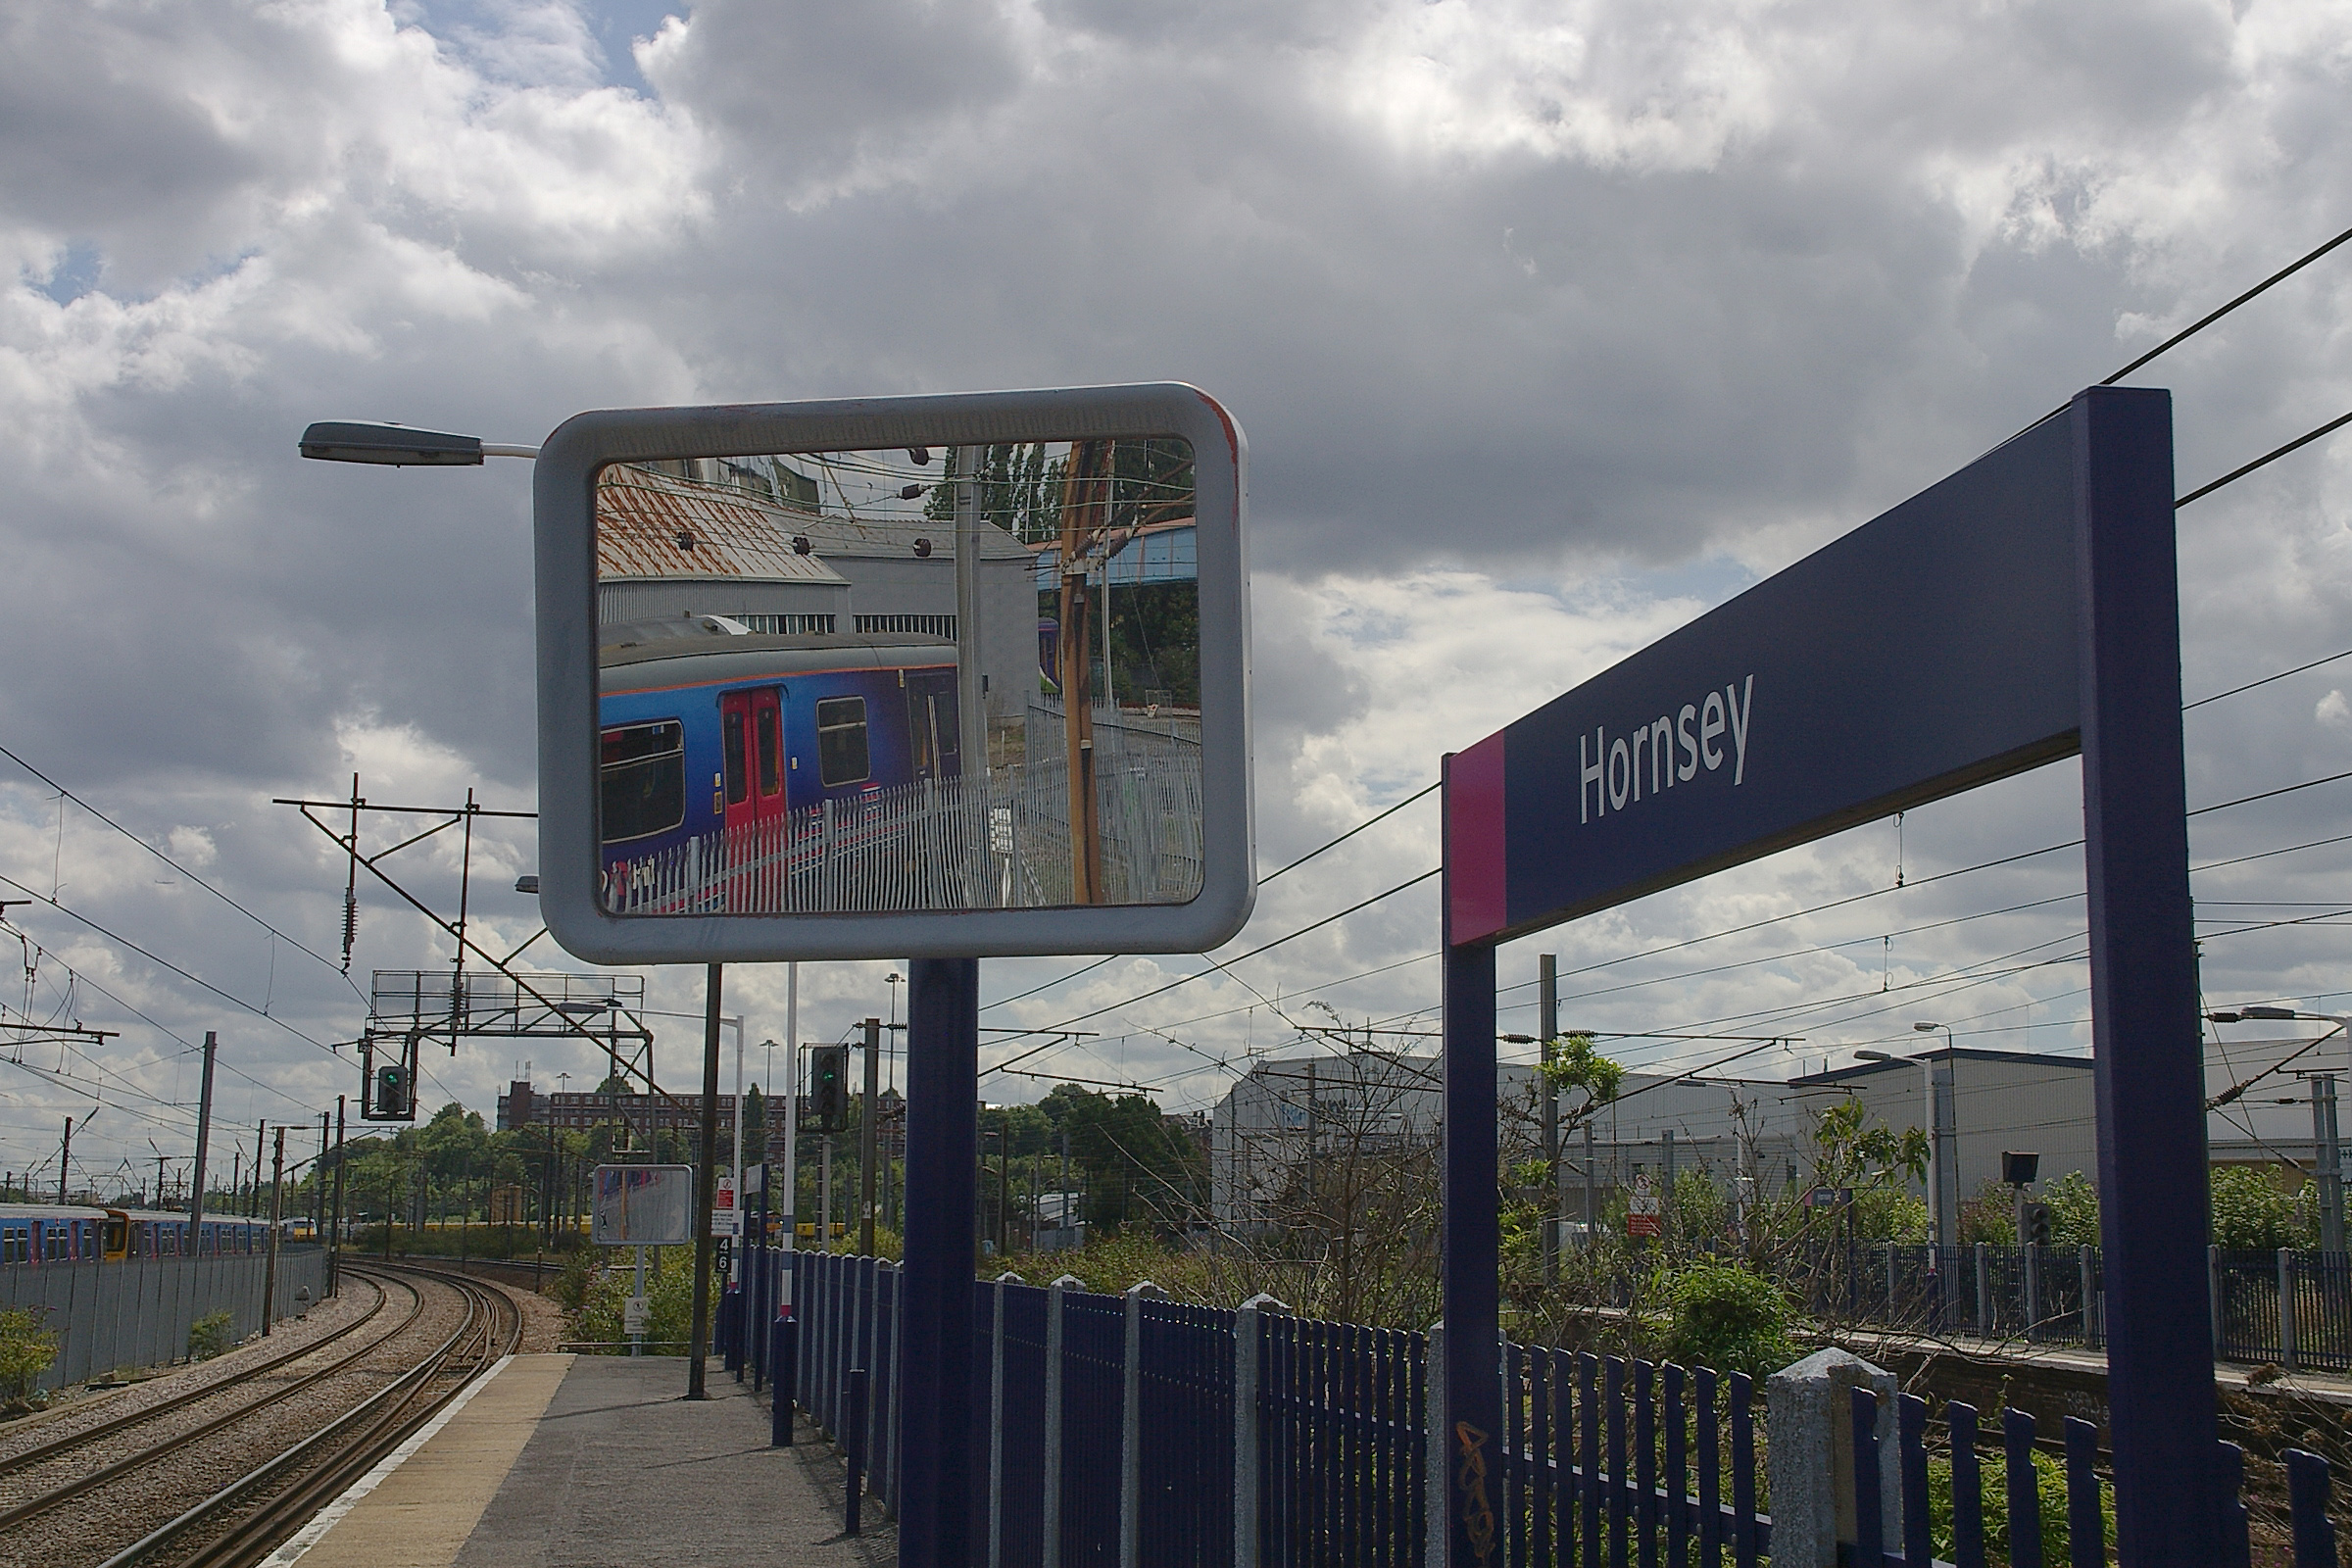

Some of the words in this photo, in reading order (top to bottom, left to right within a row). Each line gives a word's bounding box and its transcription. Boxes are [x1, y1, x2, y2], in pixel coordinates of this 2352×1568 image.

[1580, 673, 1754, 824] Hornsey
[719, 1238, 728, 1251] 4
[718, 1256, 727, 1269] 6
